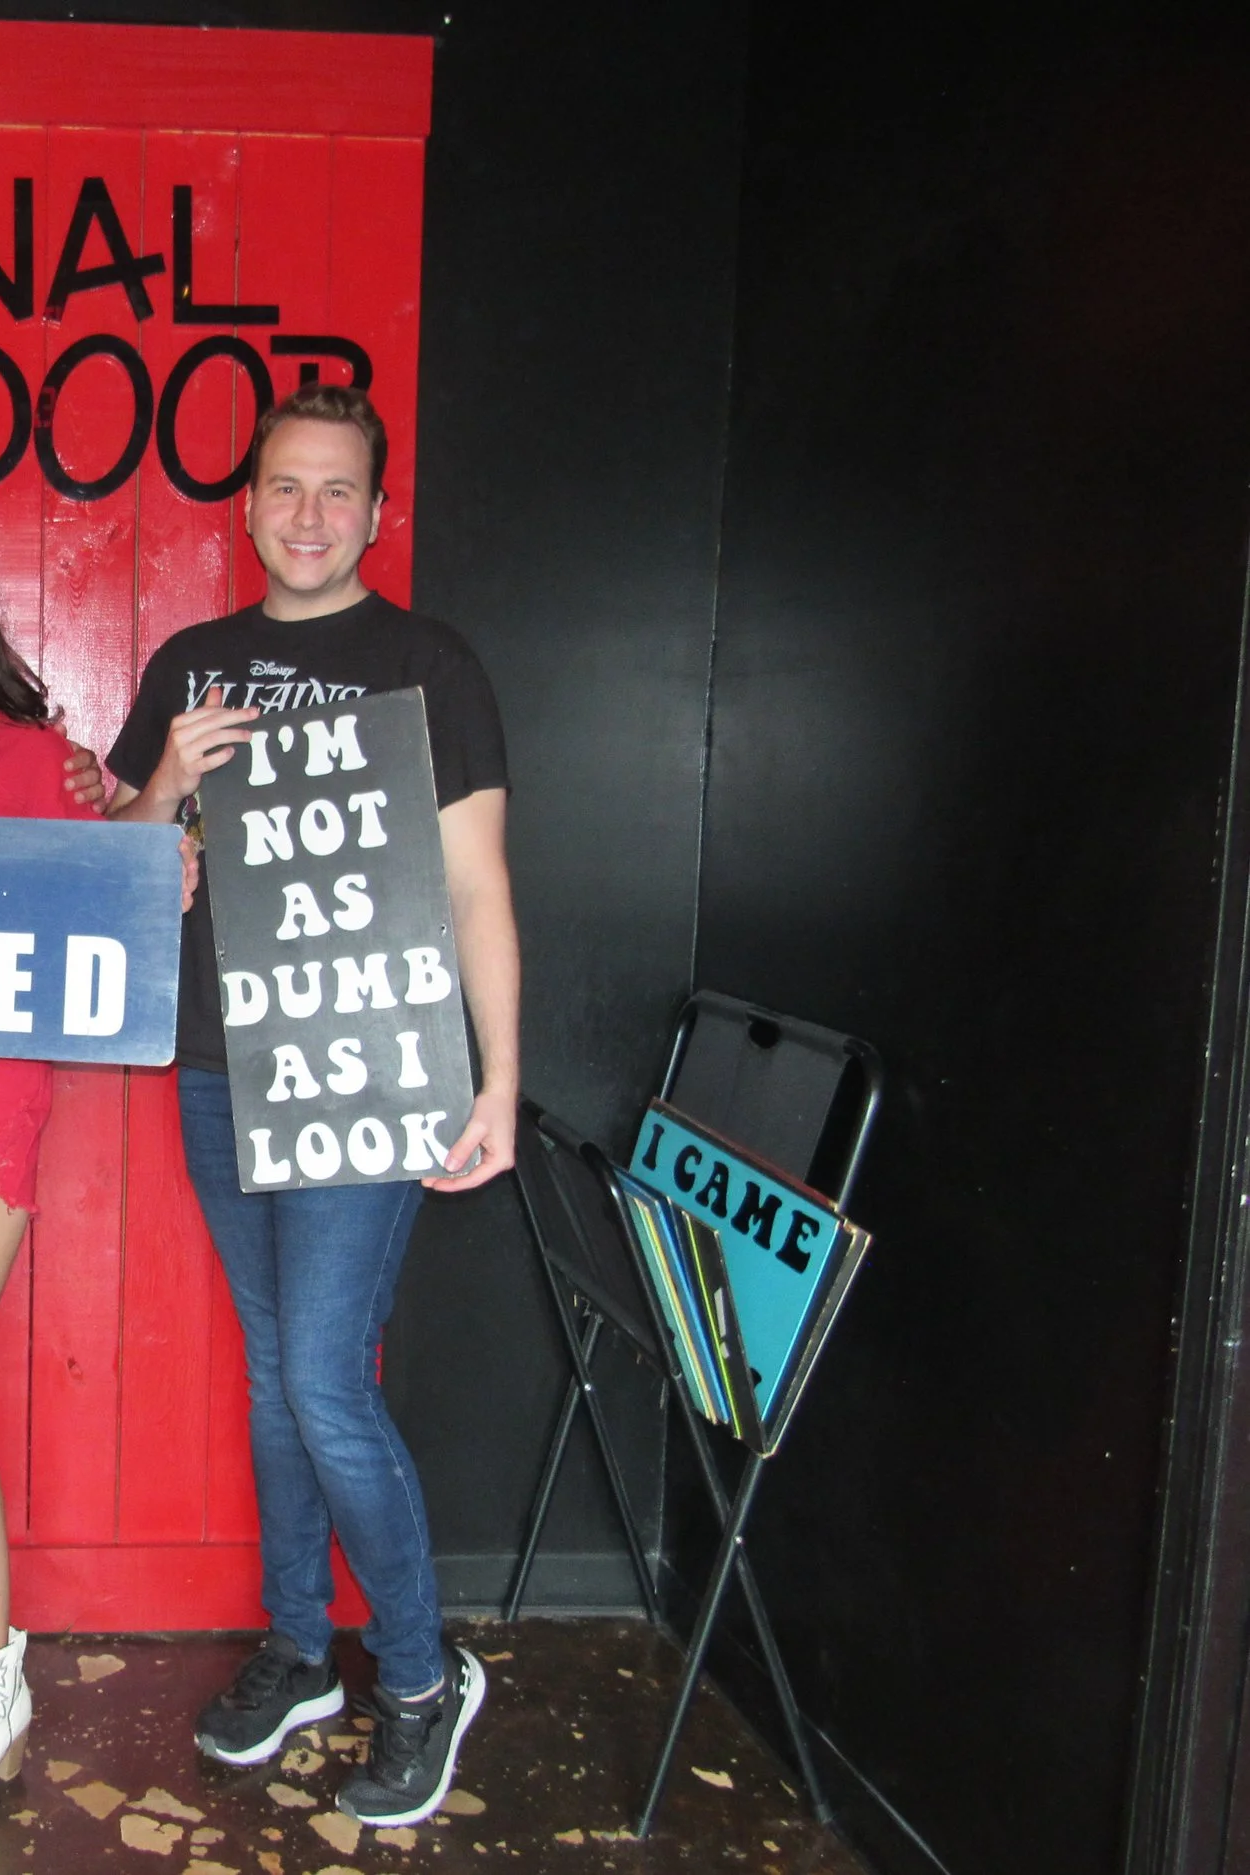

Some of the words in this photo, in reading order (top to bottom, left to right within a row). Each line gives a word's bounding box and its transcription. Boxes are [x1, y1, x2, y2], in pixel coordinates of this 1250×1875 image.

[185, 671, 367, 714] VLLAIN
[248, 714, 368, 786] I'M
[241, 790, 388, 866] NOT
[276, 873, 374, 941] AS
[222, 946, 453, 1027] DUMB
[266, 1037, 369, 1103] AS
[395, 1030, 430, 1089] I
[248, 1110, 450, 1185] LOOK
[642, 1123, 665, 1171] I
[673, 1144, 820, 1275] CAME
